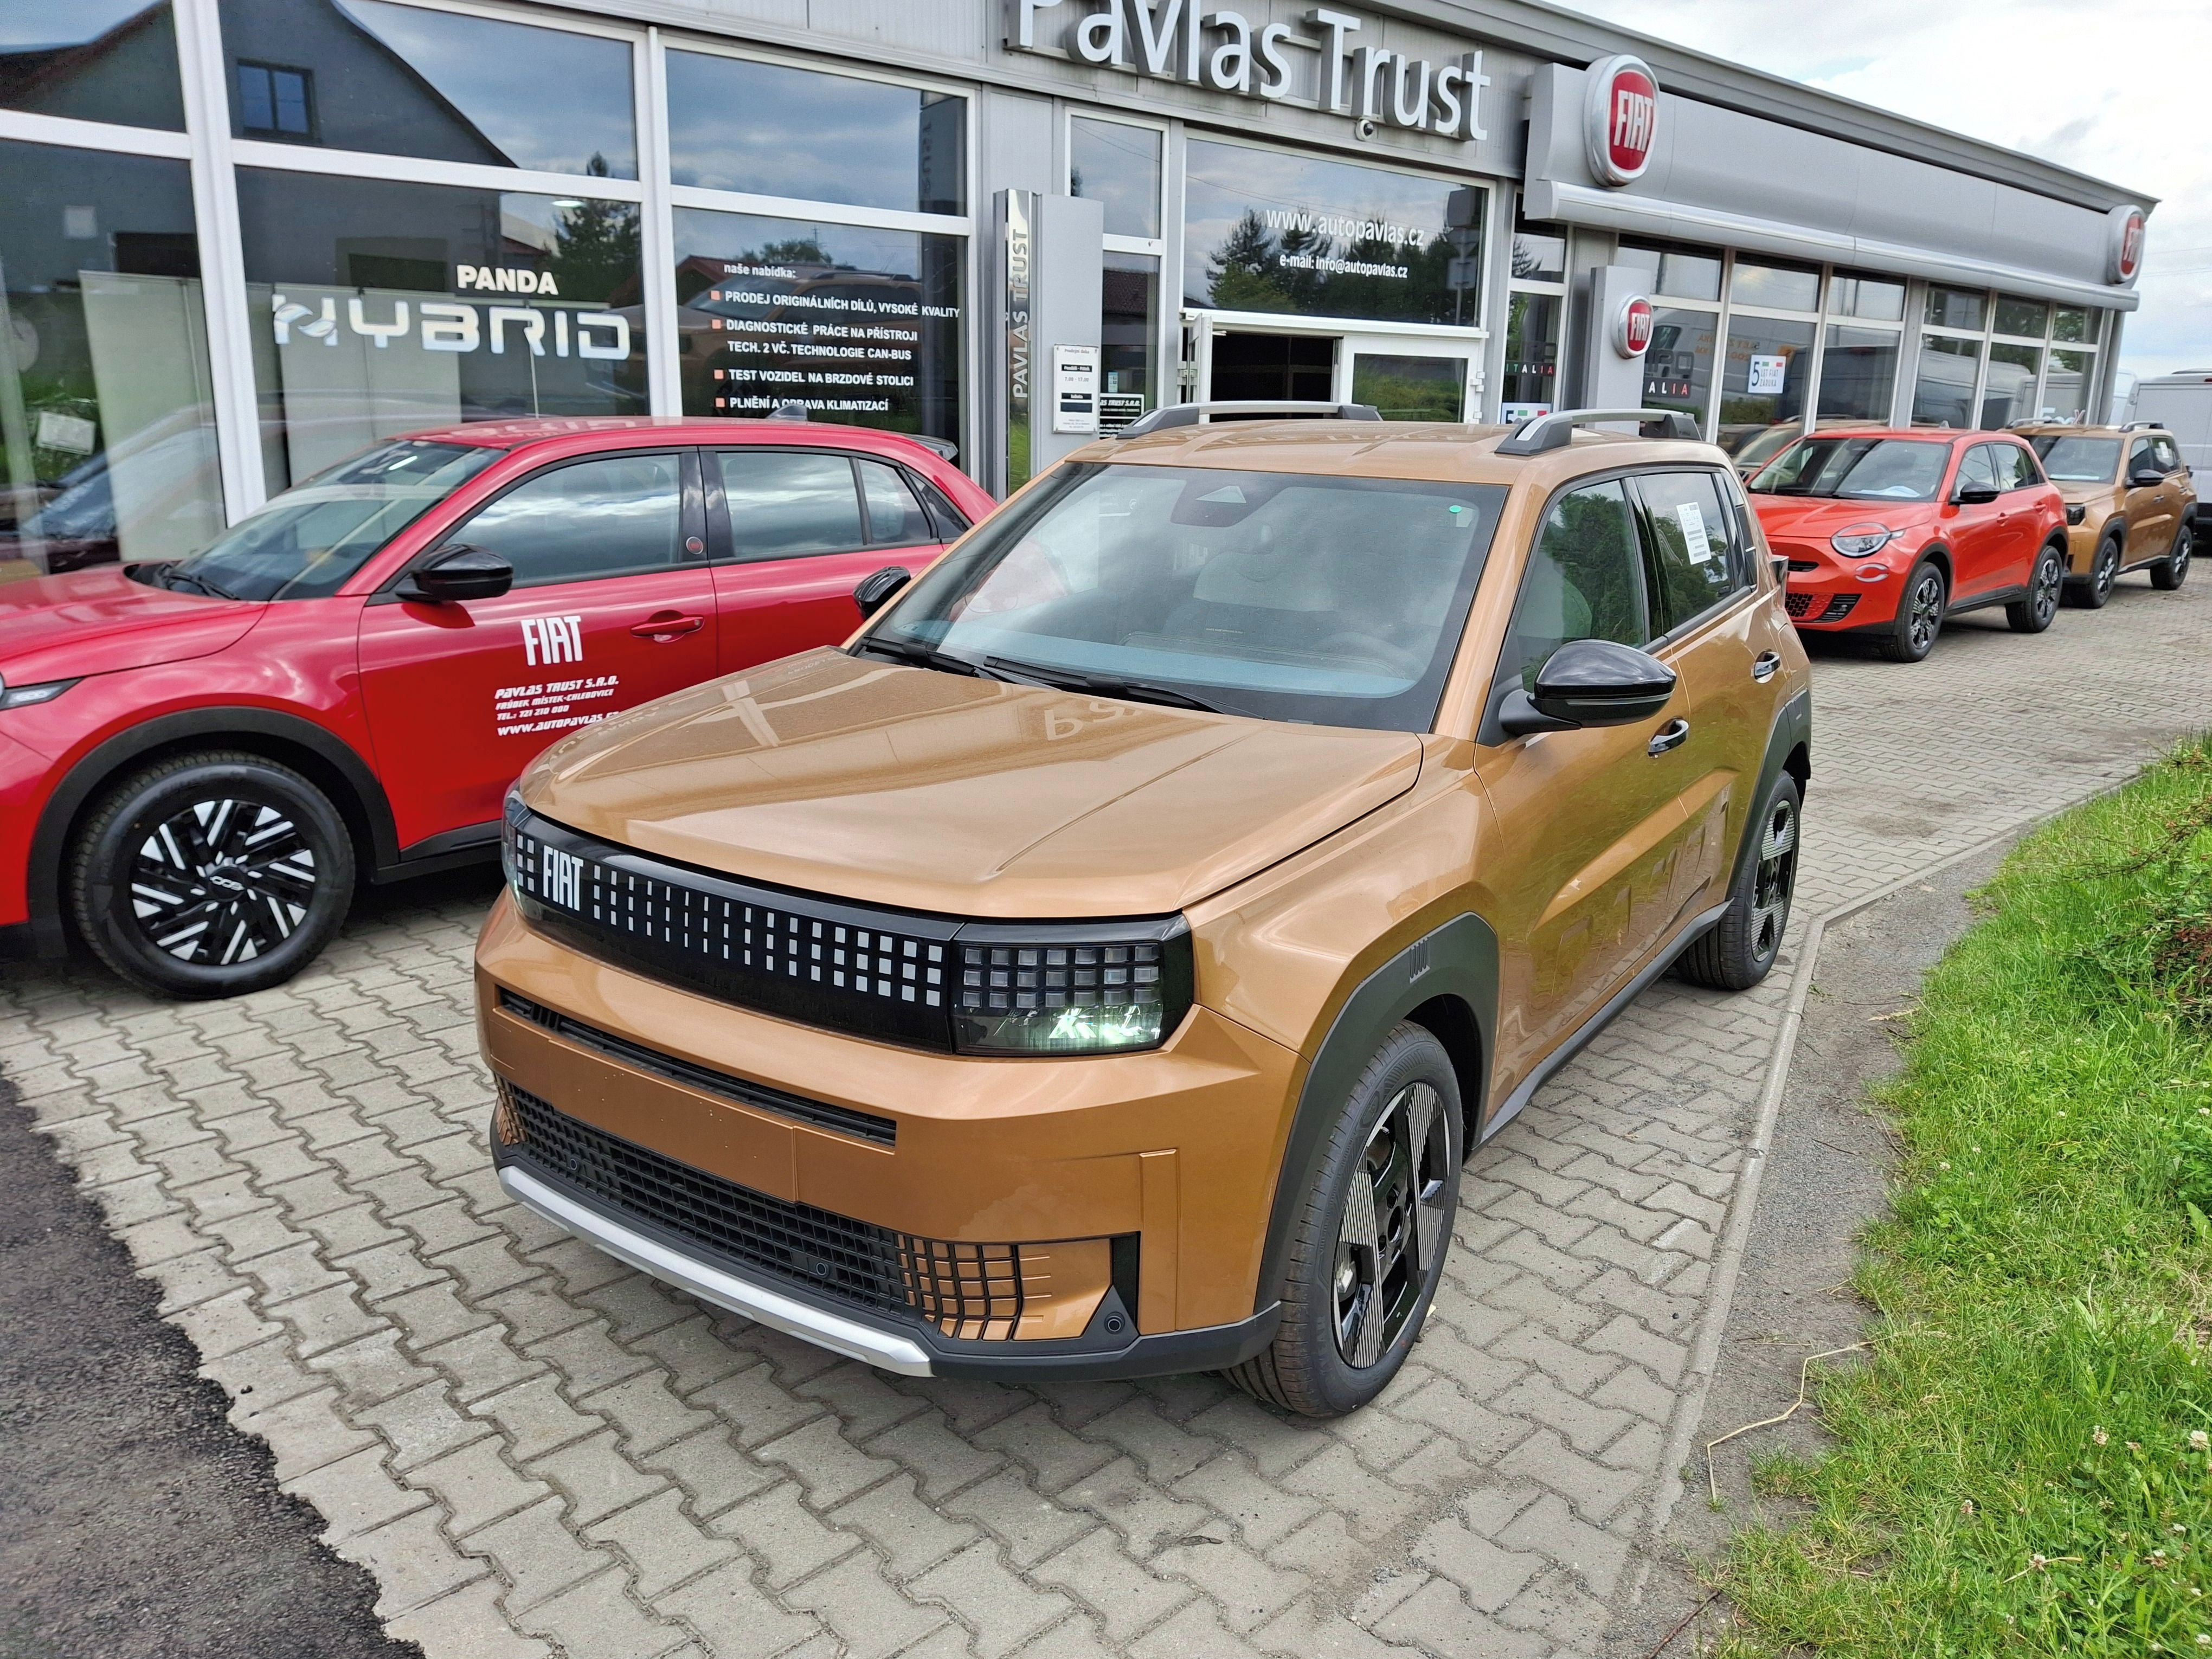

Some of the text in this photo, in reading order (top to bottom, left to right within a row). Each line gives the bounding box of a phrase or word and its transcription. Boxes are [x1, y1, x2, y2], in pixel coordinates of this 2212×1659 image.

[1306, 8, 1491, 142] Trust
[1613, 89, 1654, 152] FIAT
[1266, 209, 1424, 247] www.autopavlas.cz
[724, 263, 798, 279] naše nabídka:
[1012, 228, 1028, 301] TRUST
[1279, 254, 1408, 279] e-mail: info@autopavlas.cz
[457, 264, 558, 295] PANDA
[725, 290, 961, 318] PRODEJ ORIGINÁLNÍCH DÍLŮ, VYSOKÉ KVALITY
[272, 294, 631, 361] HYBRID
[726, 319, 918, 341] DIAGNOSTICKÉ PRÁCE NA PŘÍSTROJI
[1630, 312, 1650, 341] FIAT
[727, 340, 912, 360] TECH. 2 VČ. TECHNOLOGIE CAN-BUS
[729, 369, 914, 386] TEST VOZIDEL NA BRZDOVÉ STOLICI
[1506, 363, 1553, 374] ITALIA
[1752, 361, 1760, 387] 5
[729, 395, 770, 409] PLNĚNÍ
[771, 398, 781, 409] A
[826, 398, 889, 411] KLIMATIZACÍ
[521, 615, 583, 666] FIAT
[494, 675, 619, 699] PAVLAS TRUST S.R.O.
[497, 711, 619, 736] WWW.AUTOPAVLAS
[543, 845, 584, 911] FIAT
